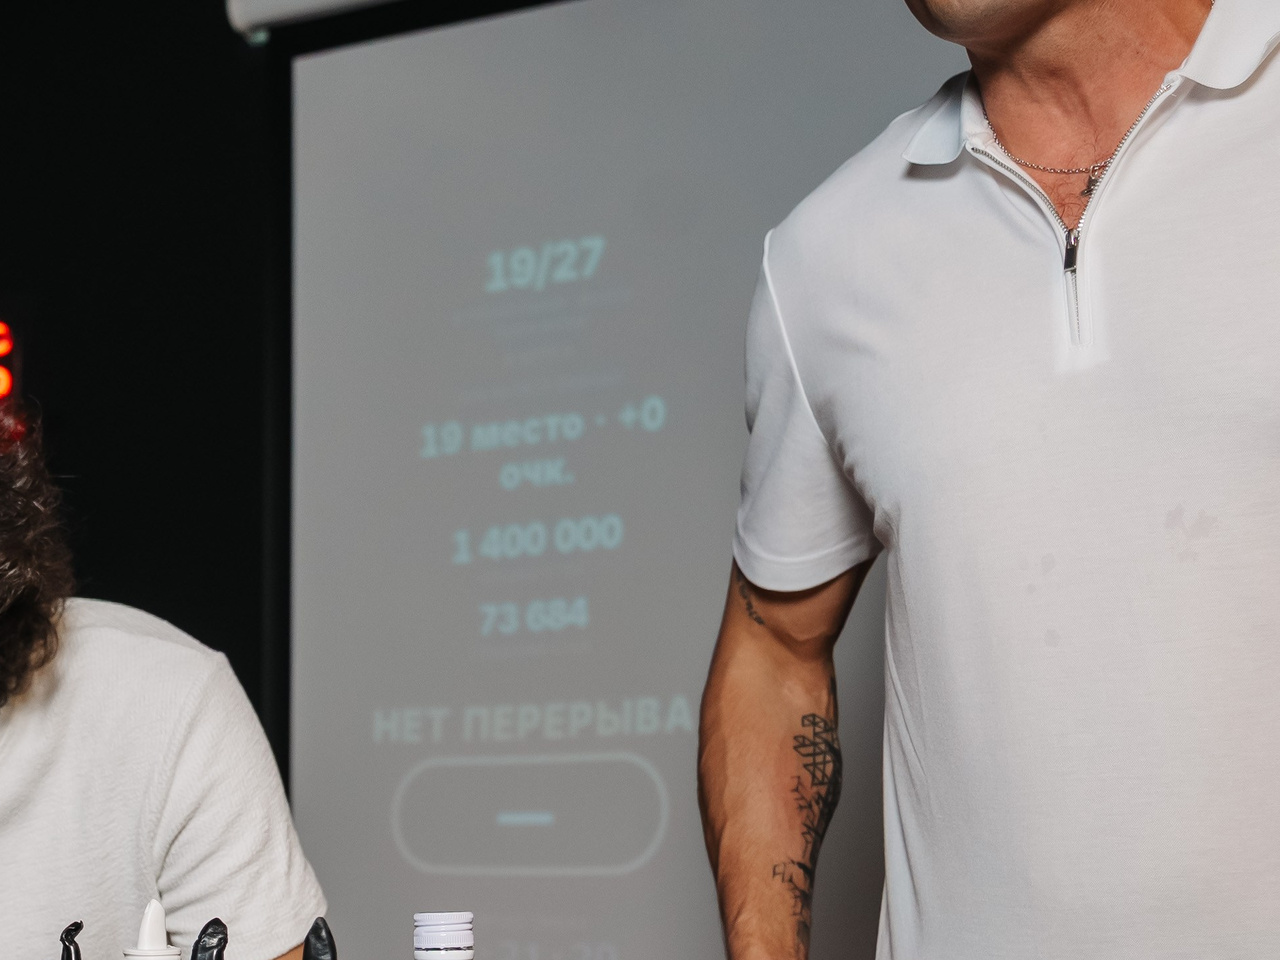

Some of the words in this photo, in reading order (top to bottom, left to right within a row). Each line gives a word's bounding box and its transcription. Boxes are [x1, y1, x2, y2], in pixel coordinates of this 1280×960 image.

[485, 236, 606, 292] 19/27
[478, 520, 548, 559] 400
[554, 513, 624, 554] 000
[372, 706, 449, 744] НЕТ
[464, 694, 693, 742] ПЕРЕРЫВА
